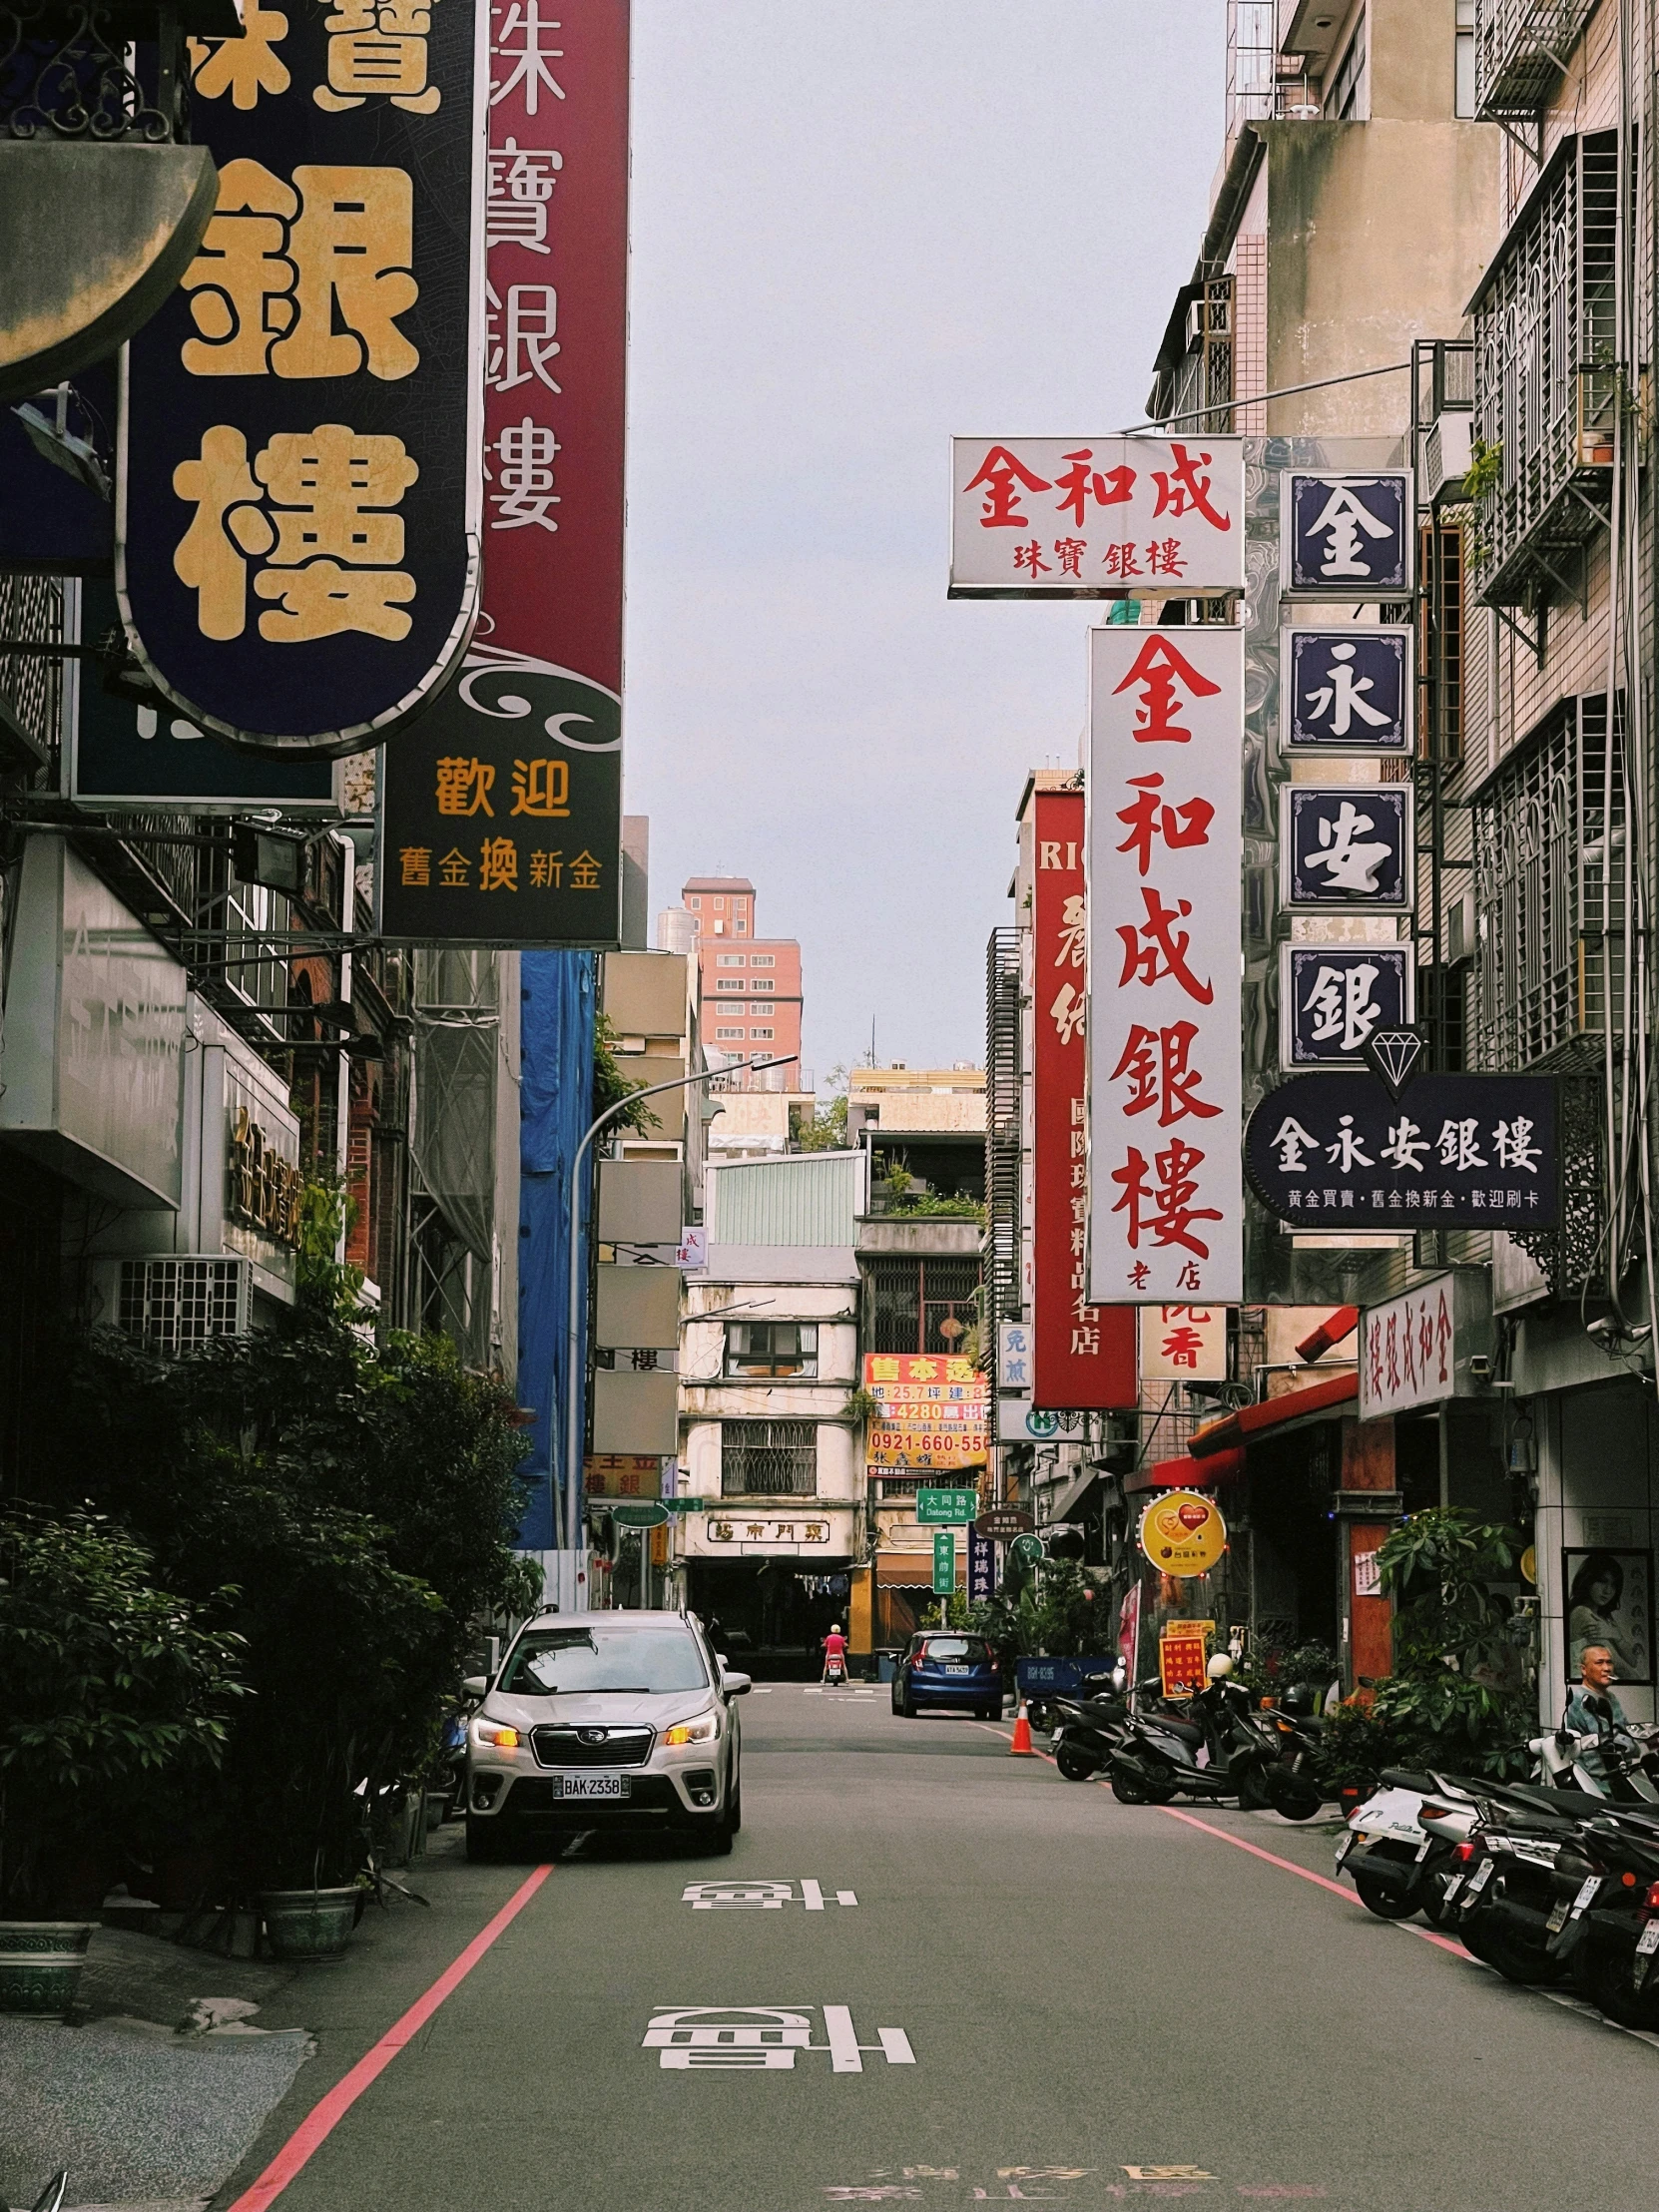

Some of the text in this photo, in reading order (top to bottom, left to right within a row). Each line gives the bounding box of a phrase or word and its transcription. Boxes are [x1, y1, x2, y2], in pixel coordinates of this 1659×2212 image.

[962, 443, 1231, 531] 金和成
[1013, 537, 1188, 579] 珠寶 銀樓
[435, 757, 570, 818] 歡迎
[1304, 478, 1394, 1048] 金永安銀
[399, 836, 602, 892] 舊金換新金
[1039, 841, 1084, 869] RI
[1109, 634, 1224, 1260] 金和成銀樓
[1270, 1115, 1542, 1173] 金永安銀樓
[1127, 1261, 1202, 1291] 老店
[871, 1433, 986, 1451] 0921-660-55
[926, 1495, 967, 1505] 大同路
[938, 1545, 949, 1587] 東前街
[974, 1534, 989, 1602] 祥瑞珠
